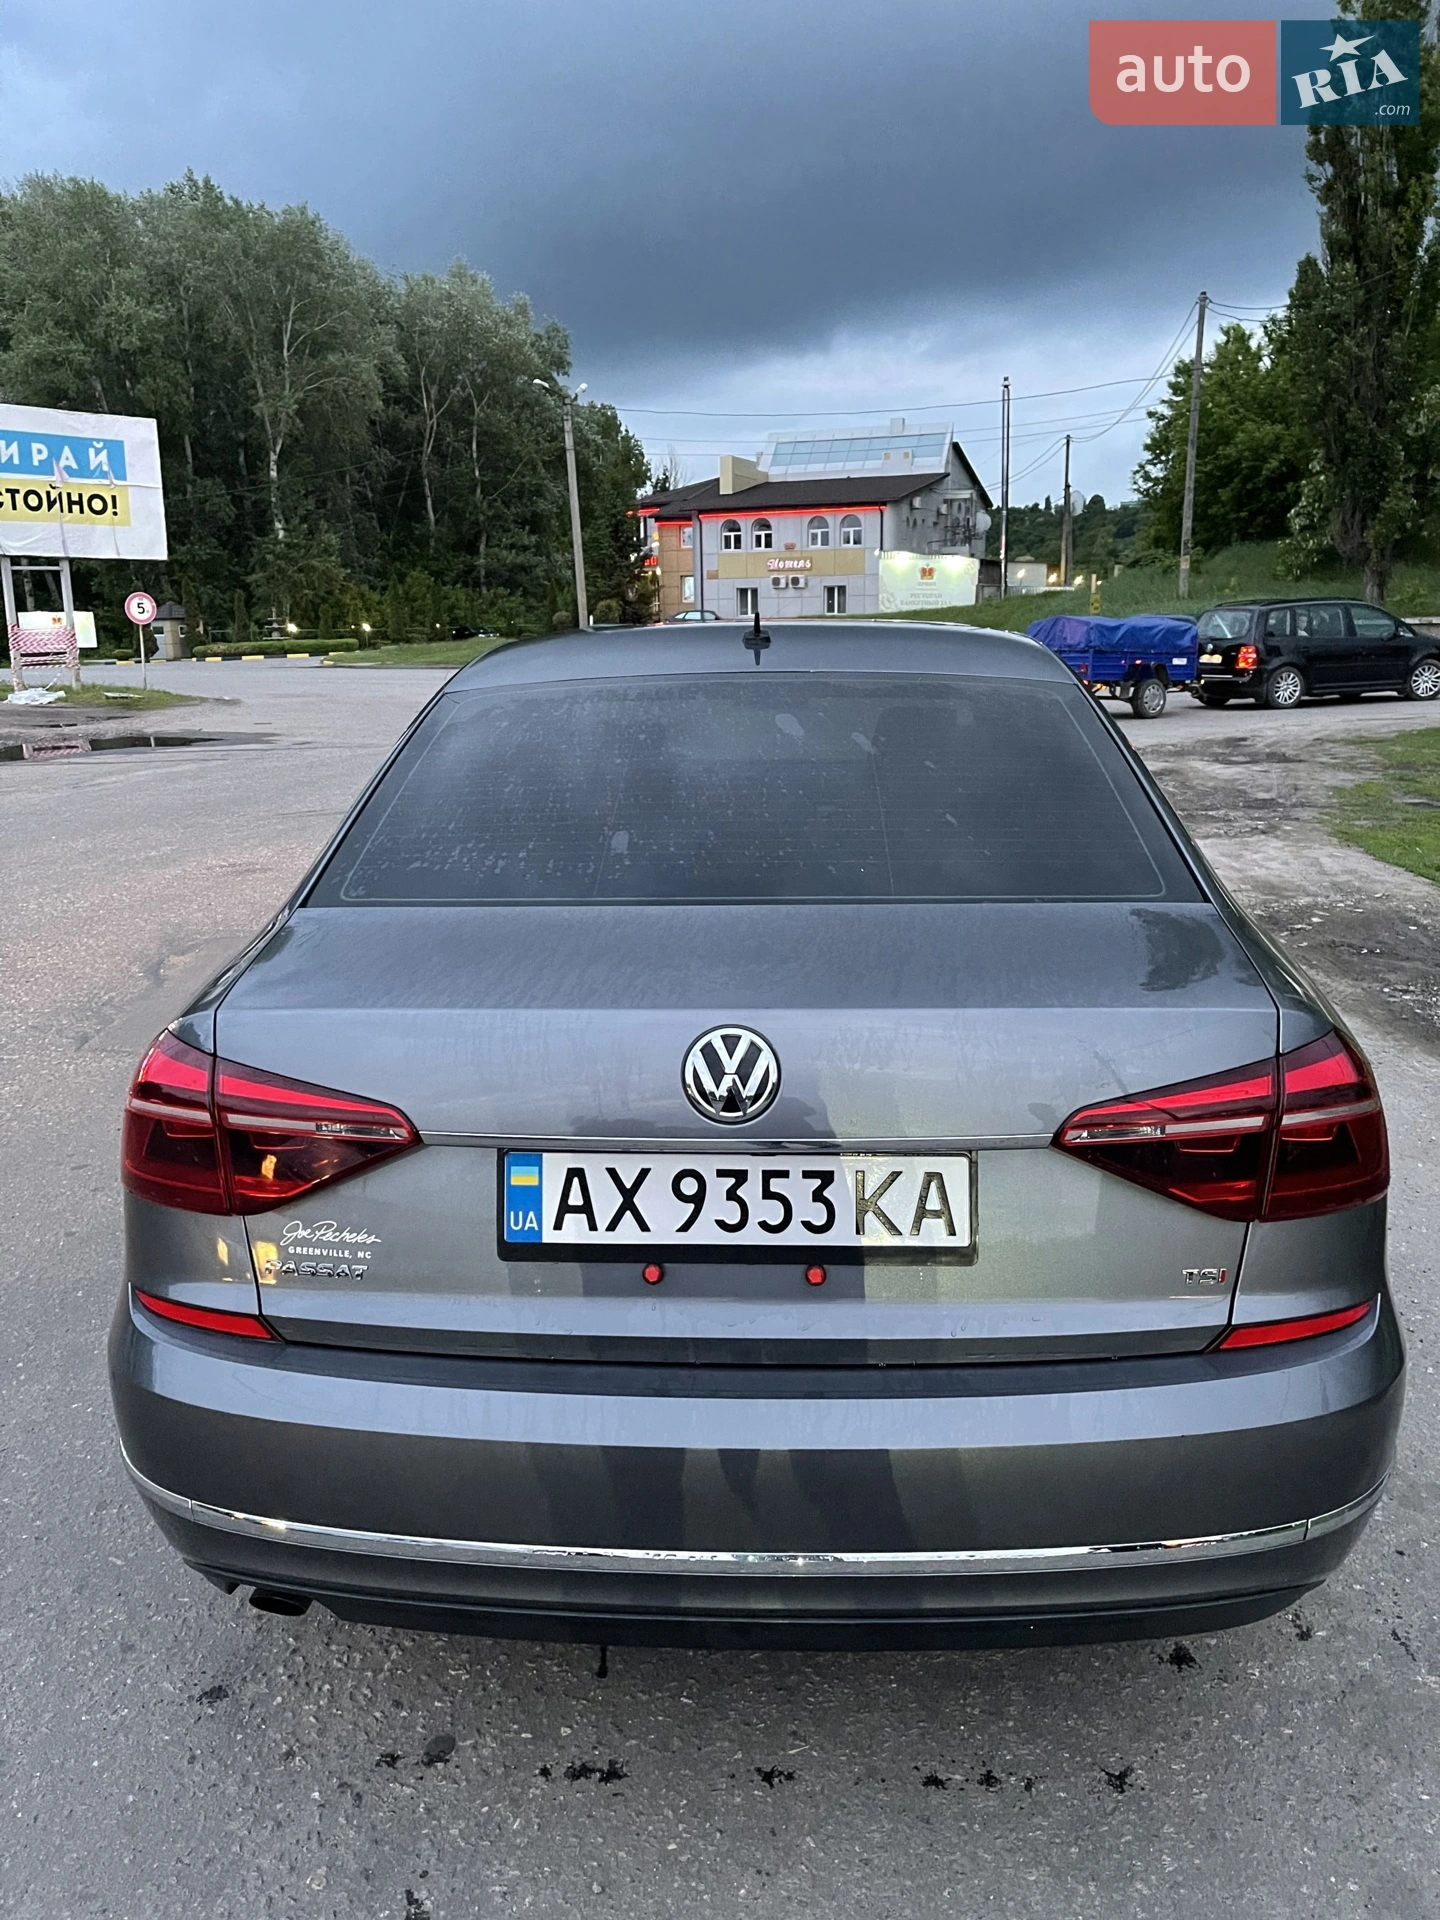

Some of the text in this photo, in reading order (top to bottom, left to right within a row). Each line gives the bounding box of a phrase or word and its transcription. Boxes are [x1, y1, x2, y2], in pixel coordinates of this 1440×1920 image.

[0, 483, 118, 517] ТОЙНО!
[137, 602, 146, 615] 5
[553, 1167, 957, 1236] AX 9353 KA
[510, 1211, 538, 1231] UA
[279, 1220, 314, 1246] Joe
[288, 1246, 372, 1259] GREENVILLE, NC
[264, 1260, 369, 1281] PASSAT
[1182, 1268, 1227, 1285] TSI
